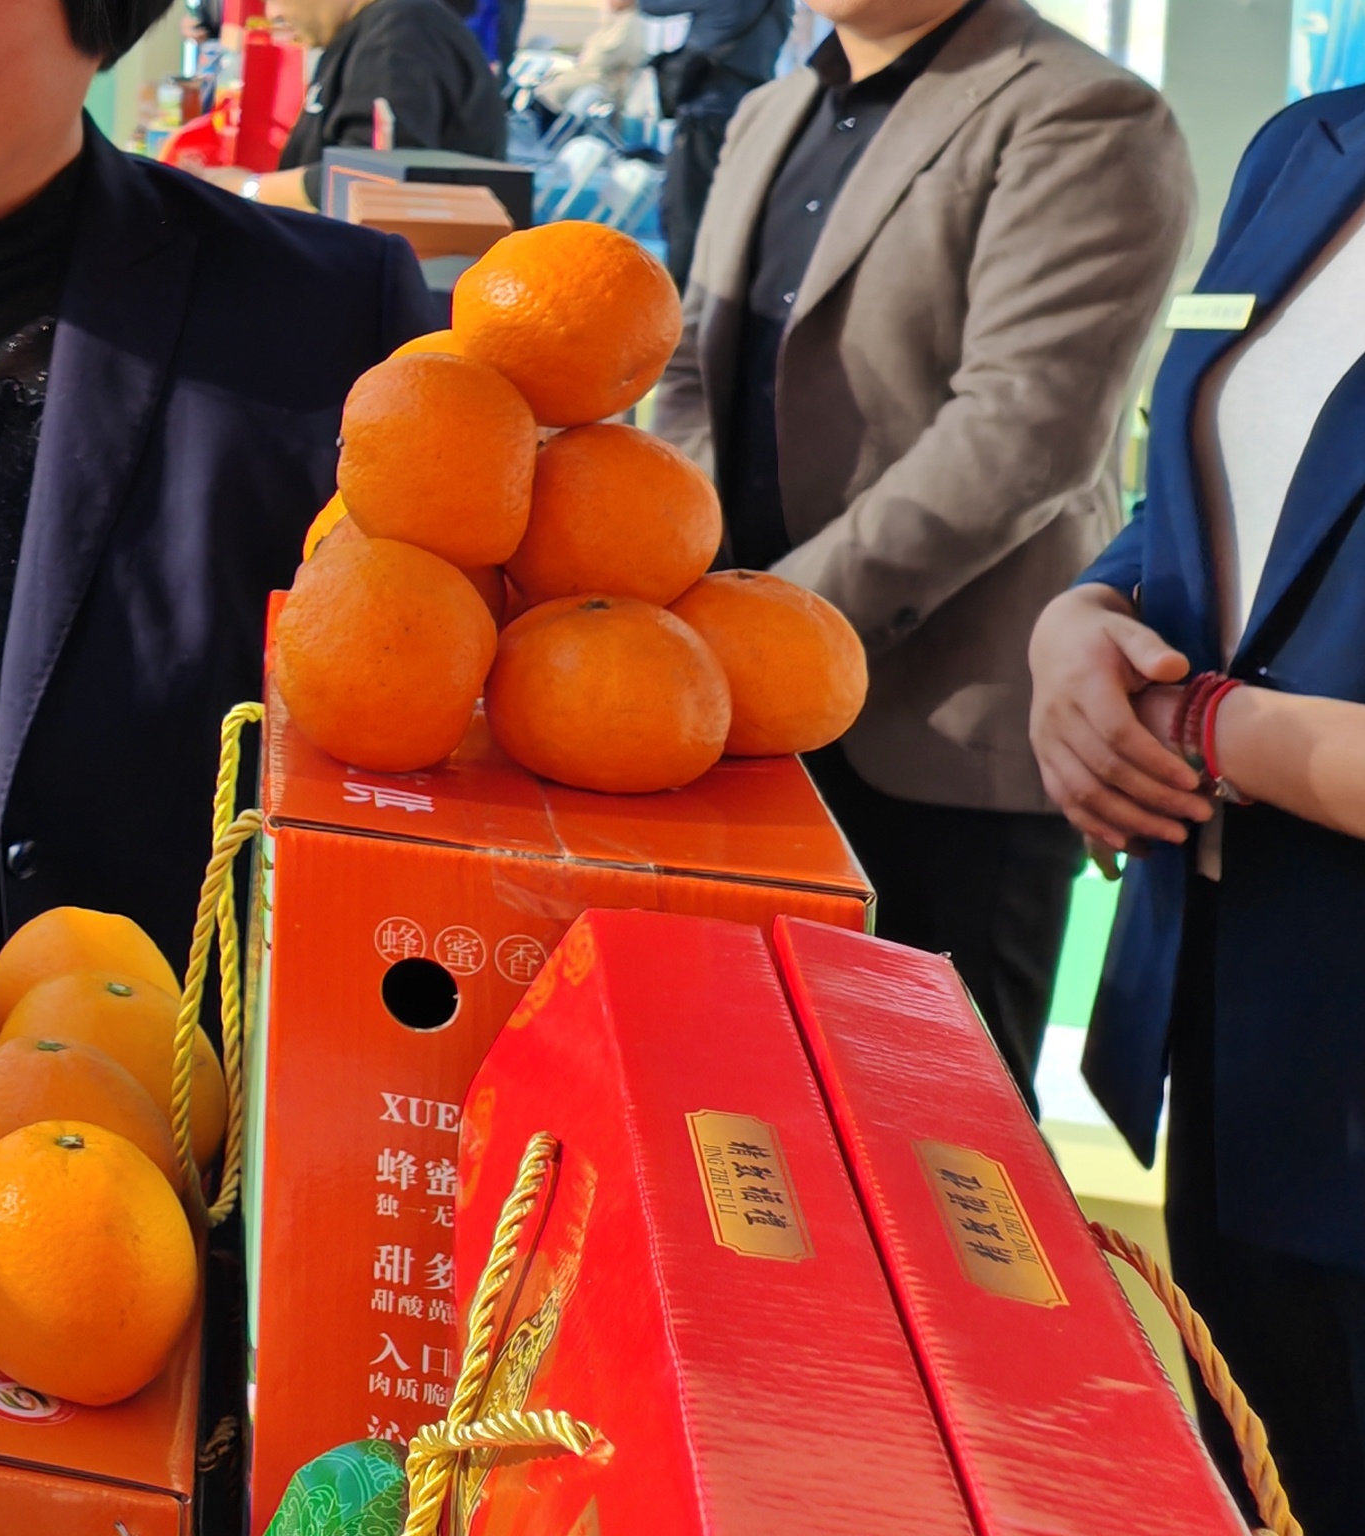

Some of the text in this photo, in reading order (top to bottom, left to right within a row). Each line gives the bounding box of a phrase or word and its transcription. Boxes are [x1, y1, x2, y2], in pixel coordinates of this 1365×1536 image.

[376, 918, 545, 982] 蜂蜜香
[379, 1092, 460, 1133] XUE
[375, 1147, 458, 1196] 蜂蜜
[703, 1143, 738, 1215] JING ZHI FU LI
[375, 1193, 455, 1227] 独一无
[369, 1332, 448, 1377] 入口
[369, 1371, 449, 1407] 肉质脆
